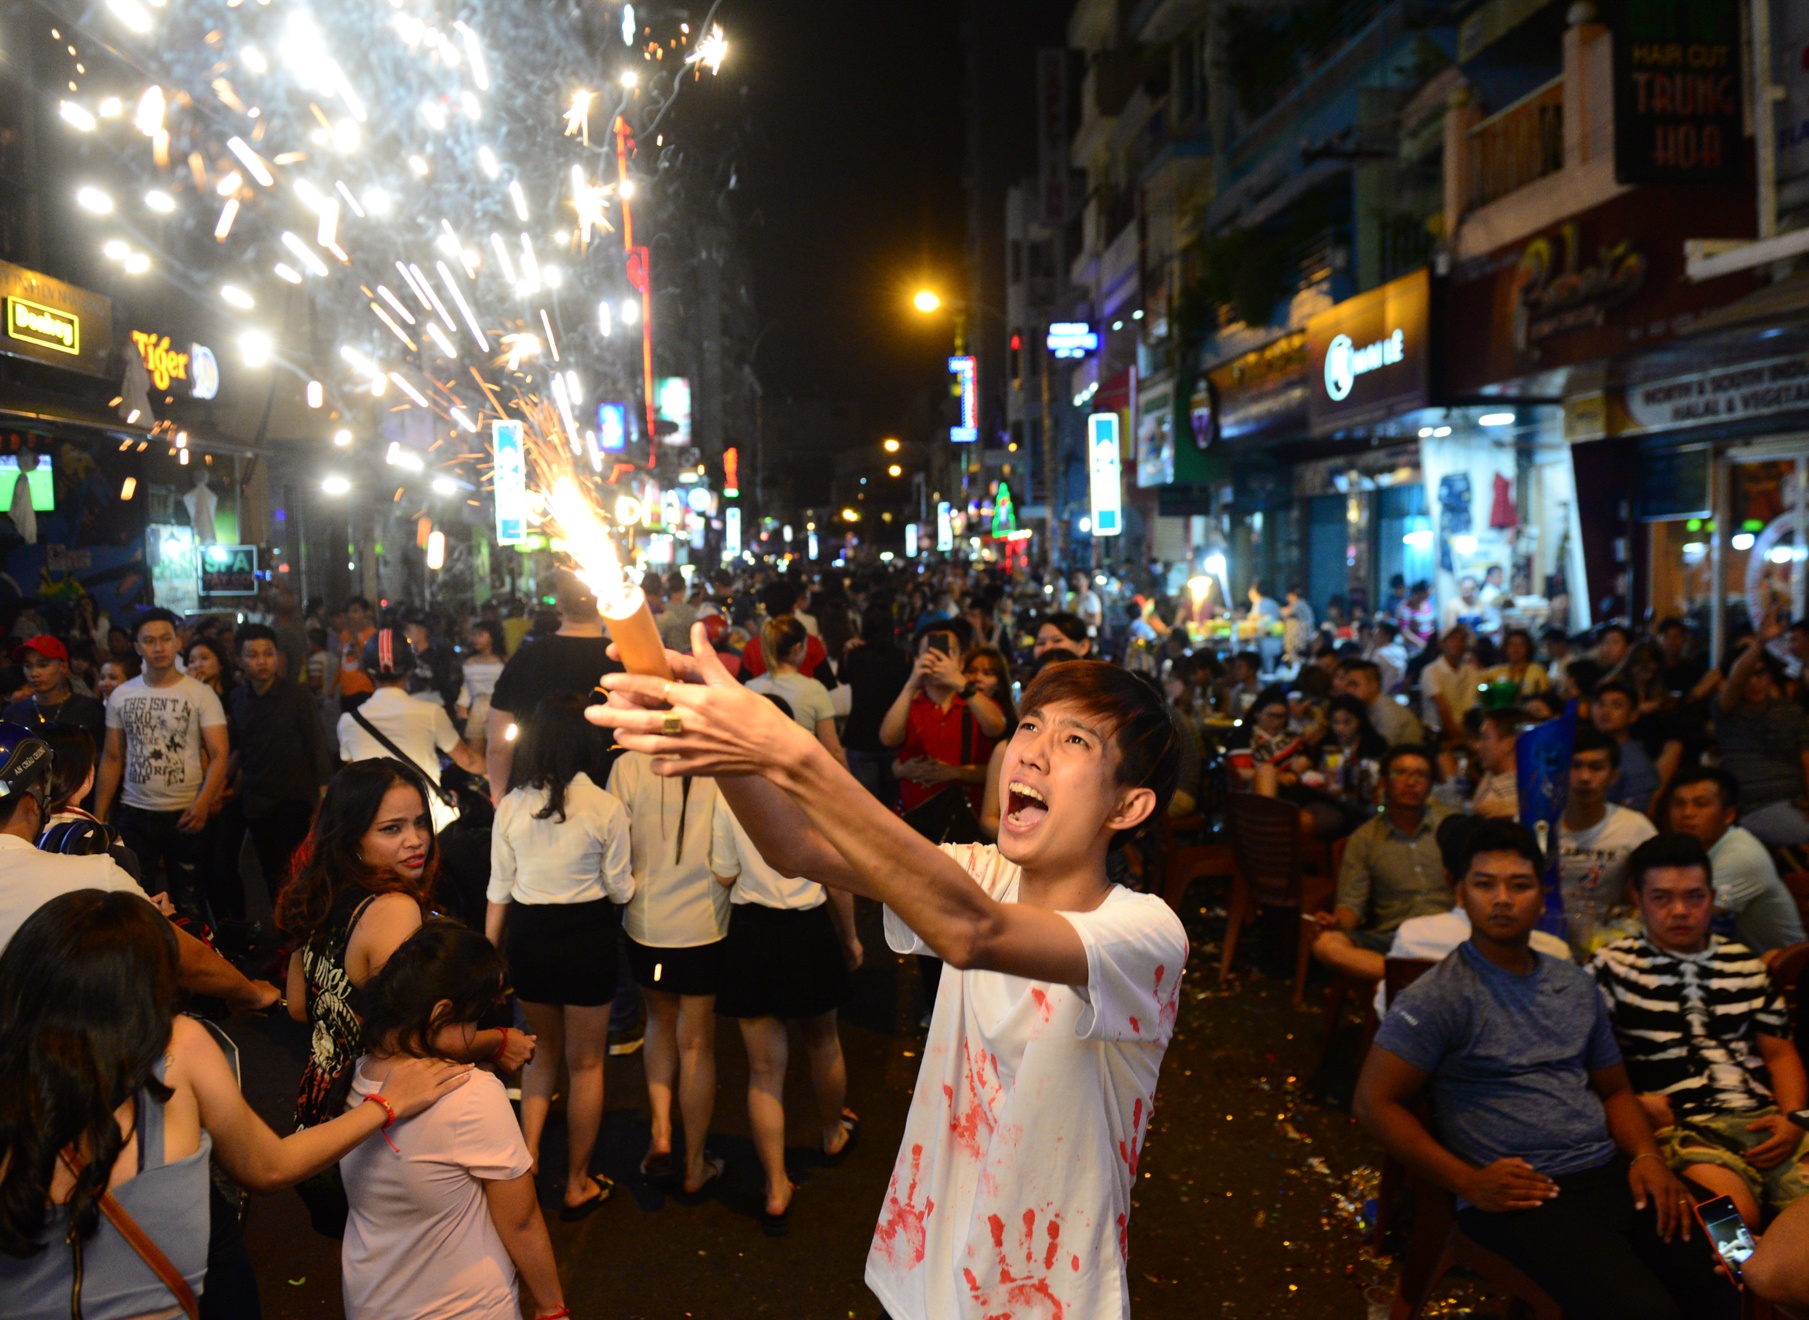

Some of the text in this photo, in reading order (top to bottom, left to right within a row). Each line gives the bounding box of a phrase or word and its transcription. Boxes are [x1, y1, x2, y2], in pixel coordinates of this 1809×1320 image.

[1632, 43, 1730, 68] HAIR CUT
[1631, 71, 1736, 117] TRUNG
[130, 329, 189, 391] Tiger
[1671, 399, 1719, 420] HALAL
[205, 545, 250, 573] SPA
[124, 697, 147, 713] THIS
[149, 696, 179, 713] ISN'T
[123, 711, 152, 725] DEMO
